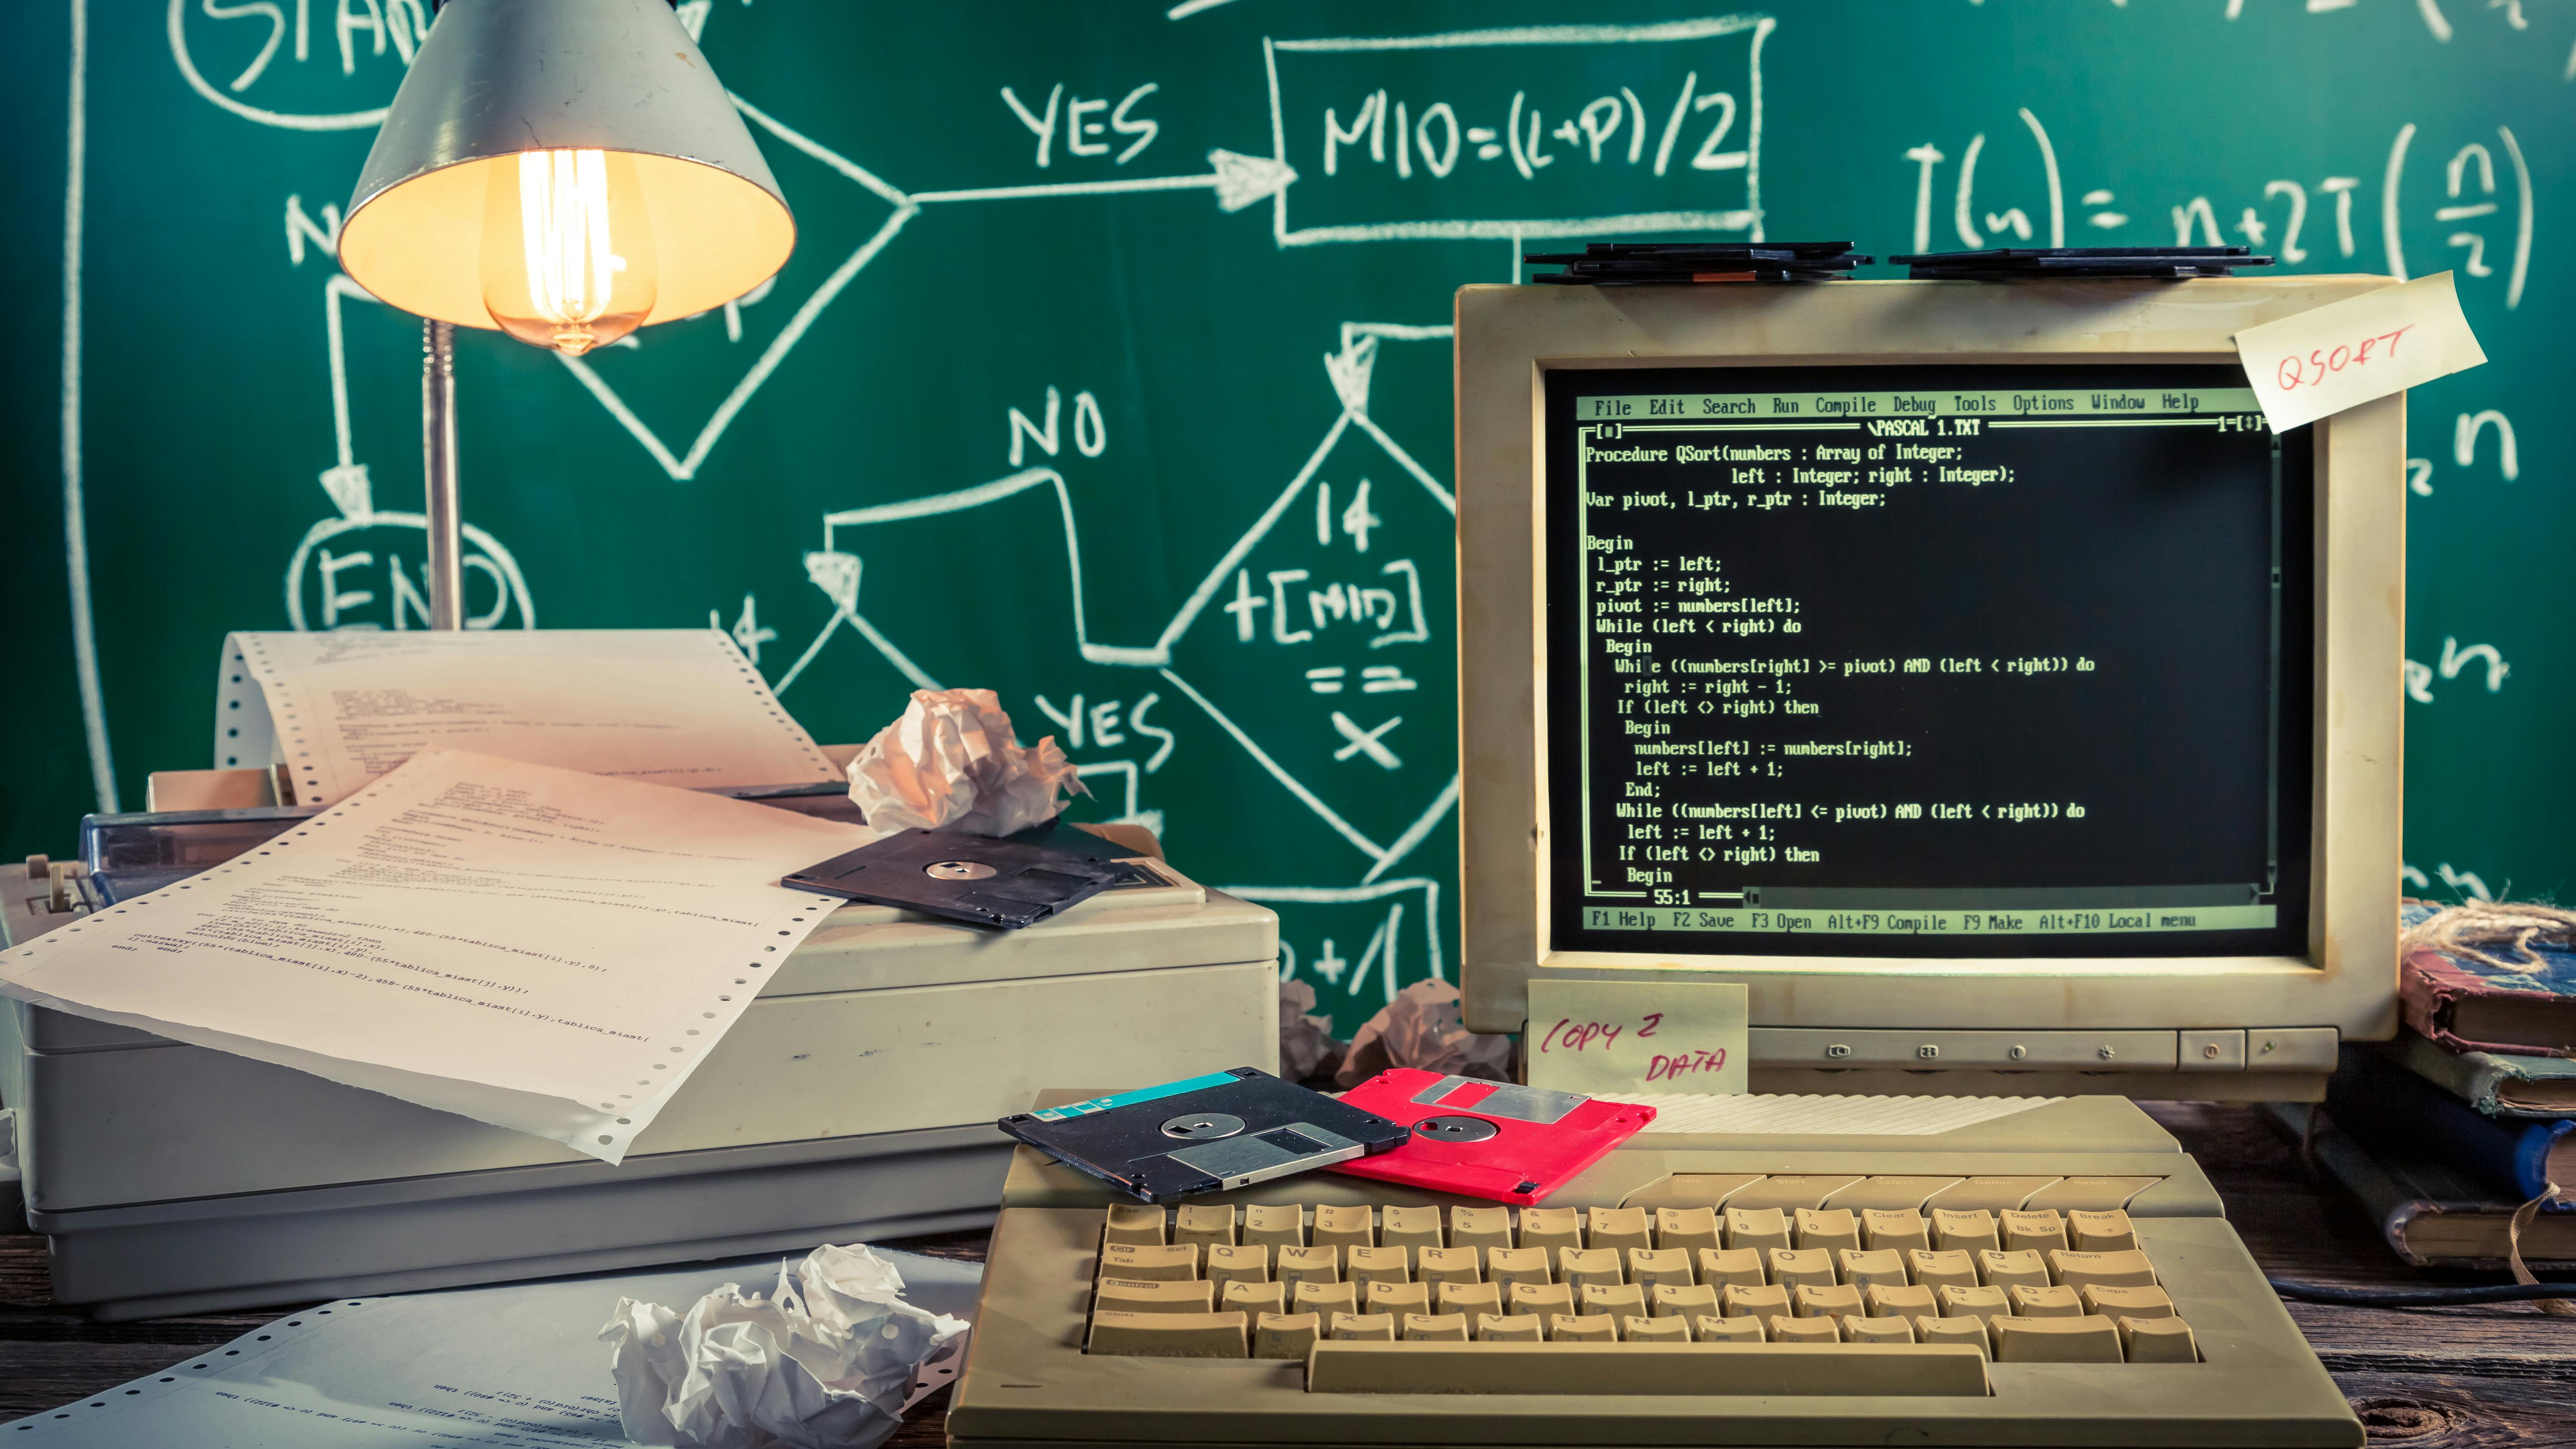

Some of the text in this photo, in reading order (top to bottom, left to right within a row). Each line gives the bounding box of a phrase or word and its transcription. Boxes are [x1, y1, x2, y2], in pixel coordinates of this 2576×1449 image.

[1001, 82, 1159, 168] YES
[2278, 323, 2416, 391] QSORT
[1595, 394, 2199, 416] File Edit Search Run Compile Debug Tools Options Window Help
[1009, 385, 1106, 467] NO
[1938, 419, 1980, 435] 1.TXT
[1586, 444, 1961, 464] Procedure QSort(numbers Array of Integer;
[1732, 466, 2014, 487] left Integer; right Integer);
[1586, 492, 1614, 506] Var
[1623, 492, 1675, 510] pivot,
[1748, 491, 1791, 510] r_ptr
[1819, 490, 1885, 509] Integer;
[1587, 536, 1633, 554] Begin
[1680, 556, 1720, 572] left;
[320, 549, 508, 631] END
[1596, 578, 1729, 595] r_ptr right;
[1596, 598, 1799, 616] pivot numbers[left];
[1596, 619, 1801, 636] While (left right) do
[1606, 639, 1652, 656] Begin
[1672, 659, 1809, 676] ((numbers[right]
[1844, 659, 1895, 676] pivot)
[1904, 659, 1930, 672] AND
[1940, 658, 1982, 672] (left
[2007, 657, 2067, 675] right))
[2077, 657, 2094, 671] do
[1625, 679, 1790, 697] right right 1;
[1618, 700, 1818, 717] If (left right) then
[1036, 692, 1174, 773] YES
[1625, 720, 1670, 737] Begin
[1634, 741, 1910, 759] numbers[left] numbers[right];
[1637, 761, 1782, 777] left left 1;
[1626, 782, 1659, 798] End;
[1617, 803, 2085, 823] While ((numbers[left] pivot) AND (left right)) do
[1628, 824, 1774, 841] left left 1;
[1620, 846, 1819, 865] If (left right) then
[1627, 867, 1672, 886] Begin
[1654, 889, 1690, 904] 55:1
[1592, 911, 2196, 933] F1 Help F2 Save F3 Open Alt+F9 Compile F9 Make Alt+F10 Local menu
[1541, 1019, 1623, 1053] COPY
[1646, 1048, 1726, 1081] DATA
[1216, 1248, 1234, 1258] Q
[1286, 1248, 1309, 1258] W
[1357, 1248, 1372, 1258] E
[1428, 1249, 1443, 1259] R
[1496, 1250, 1512, 1259] T
[1568, 1250, 1583, 1259] Y
[1638, 1251, 1654, 1260] U
[1778, 1252, 1796, 1261] O
[1849, 1252, 1864, 1260] P
